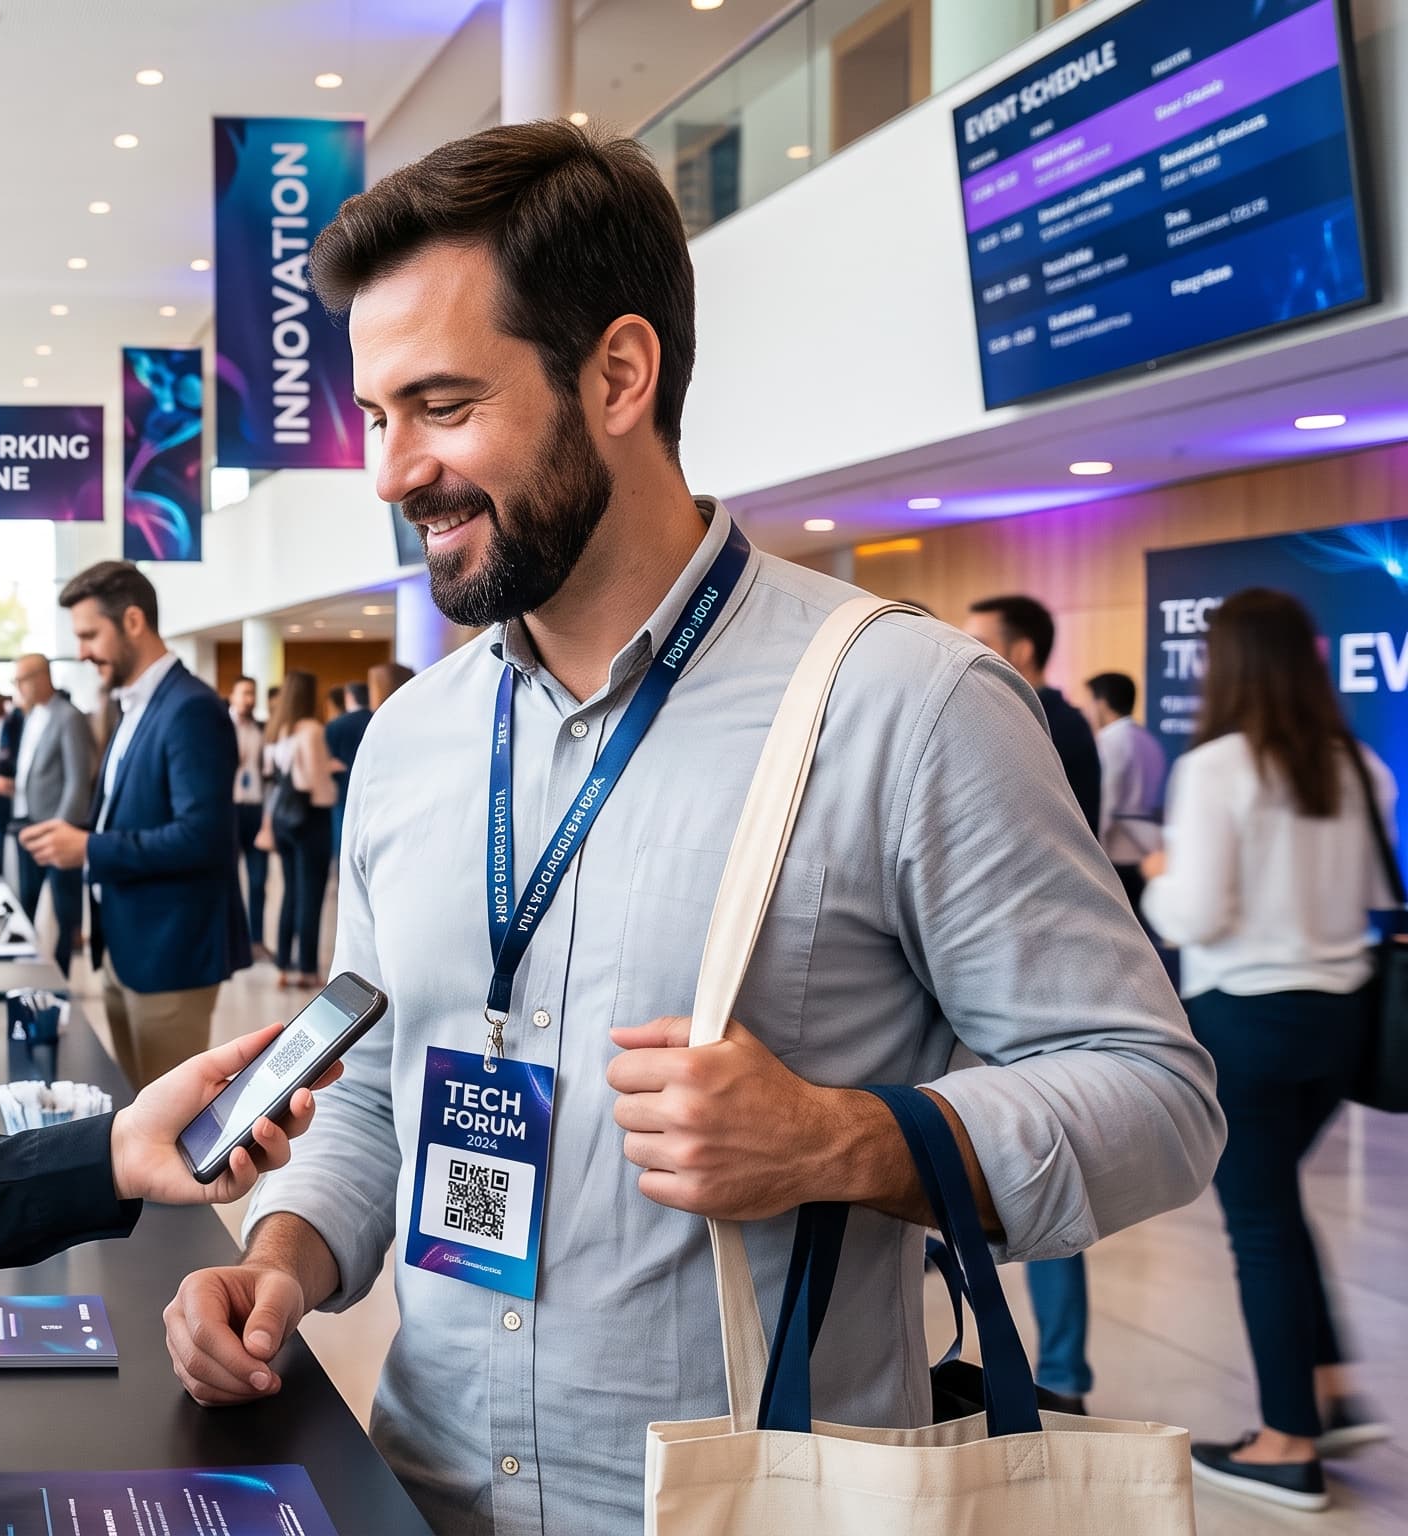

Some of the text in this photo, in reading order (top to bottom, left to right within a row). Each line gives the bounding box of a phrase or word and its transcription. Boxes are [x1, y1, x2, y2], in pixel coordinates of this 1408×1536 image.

[964, 93, 1020, 144] EVENT
[1019, 40, 1118, 114] SCHEDULE
[271, 142, 311, 444] INNOVATION
[1159, 597, 1225, 635] TEC
[444, 1079, 522, 1116] TECH
[442, 1107, 527, 1141] FORUM
[466, 1134, 499, 1150] 2024
